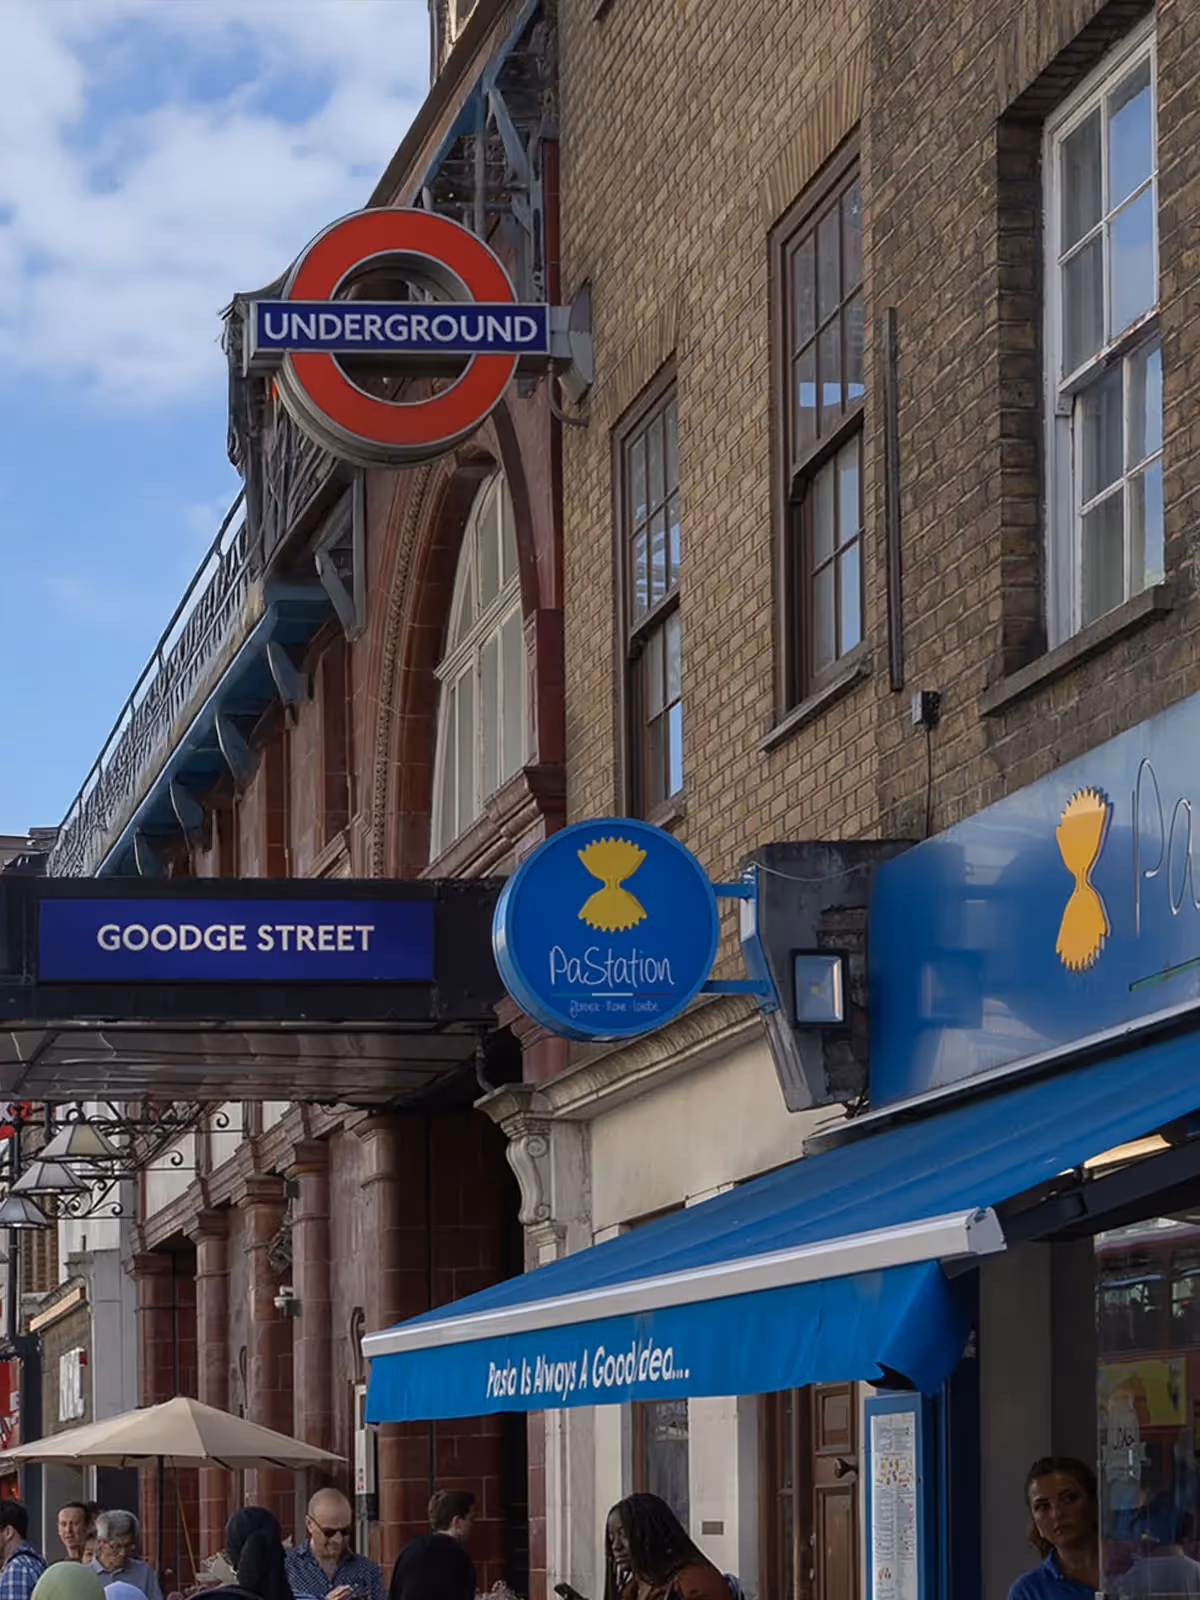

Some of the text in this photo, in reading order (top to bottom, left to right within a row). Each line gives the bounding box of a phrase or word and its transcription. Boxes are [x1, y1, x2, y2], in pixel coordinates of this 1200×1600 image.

[265, 312, 538, 342] UNDERGROUND
[97, 923, 376, 952] GOODGE STREET
[549, 945, 675, 988] PaStation
[486, 1358, 516, 1398] Pasta
[520, 1356, 531, 1395] Is
[533, 1354, 576, 1401] Always
[578, 1349, 588, 1390] A
[593, 1340, 636, 1388] Good
